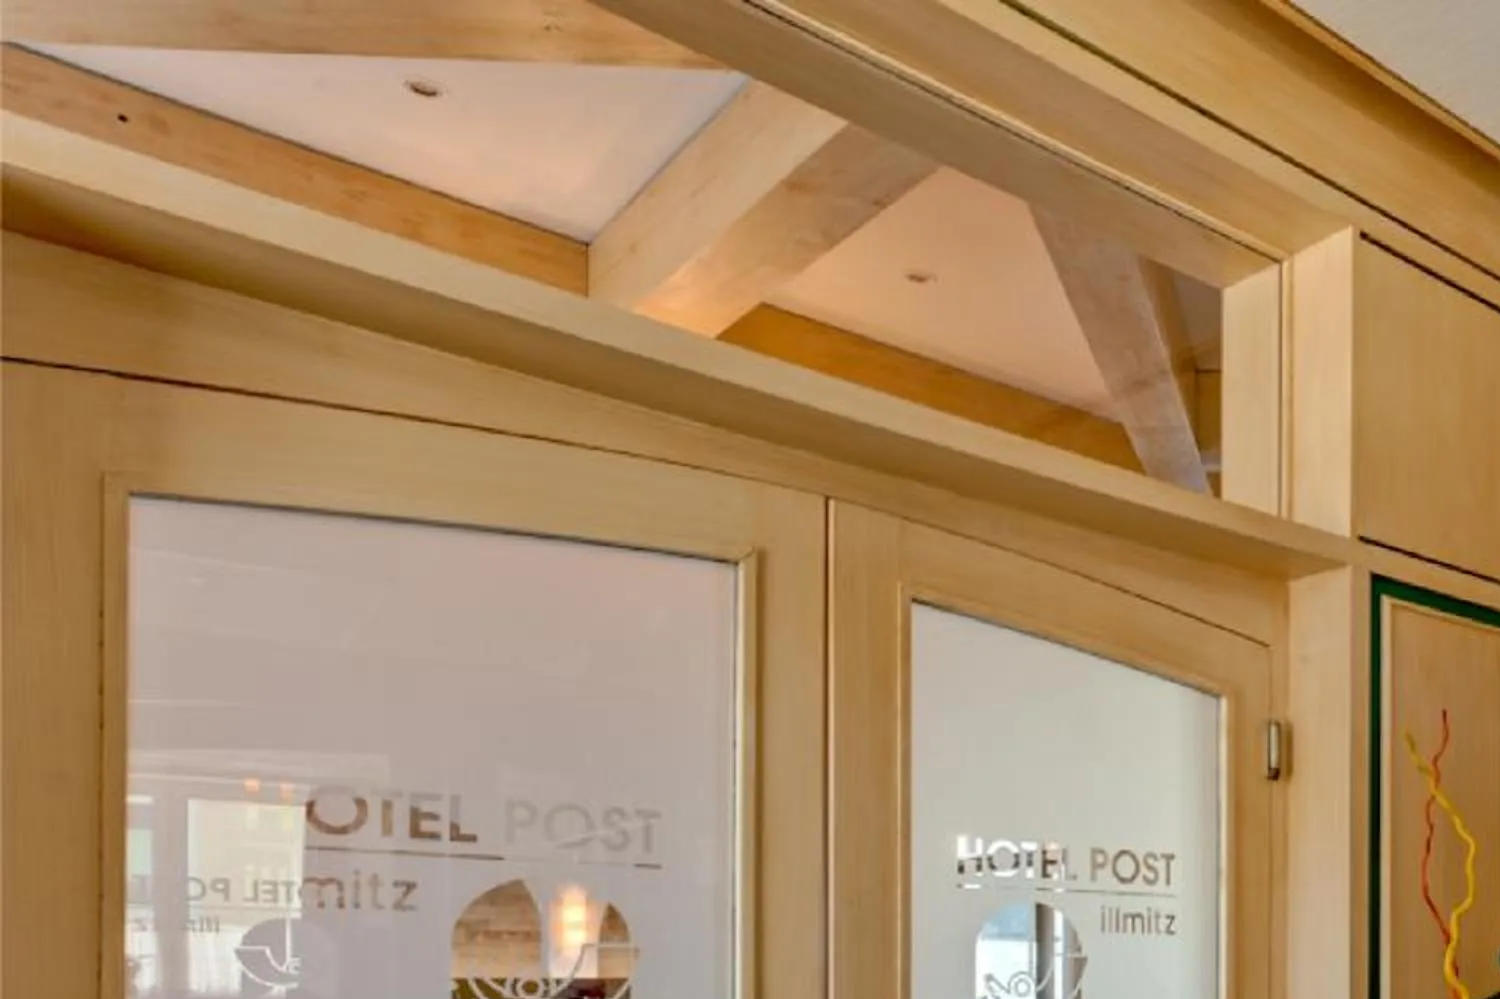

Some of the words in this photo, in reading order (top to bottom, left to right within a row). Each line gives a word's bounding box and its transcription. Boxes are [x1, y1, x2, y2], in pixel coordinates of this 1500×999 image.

[505, 798, 662, 854] POST
[956, 834, 1078, 881] HOTEL
[1090, 848, 1176, 886] POST
[1100, 906, 1177, 935] illmitz
